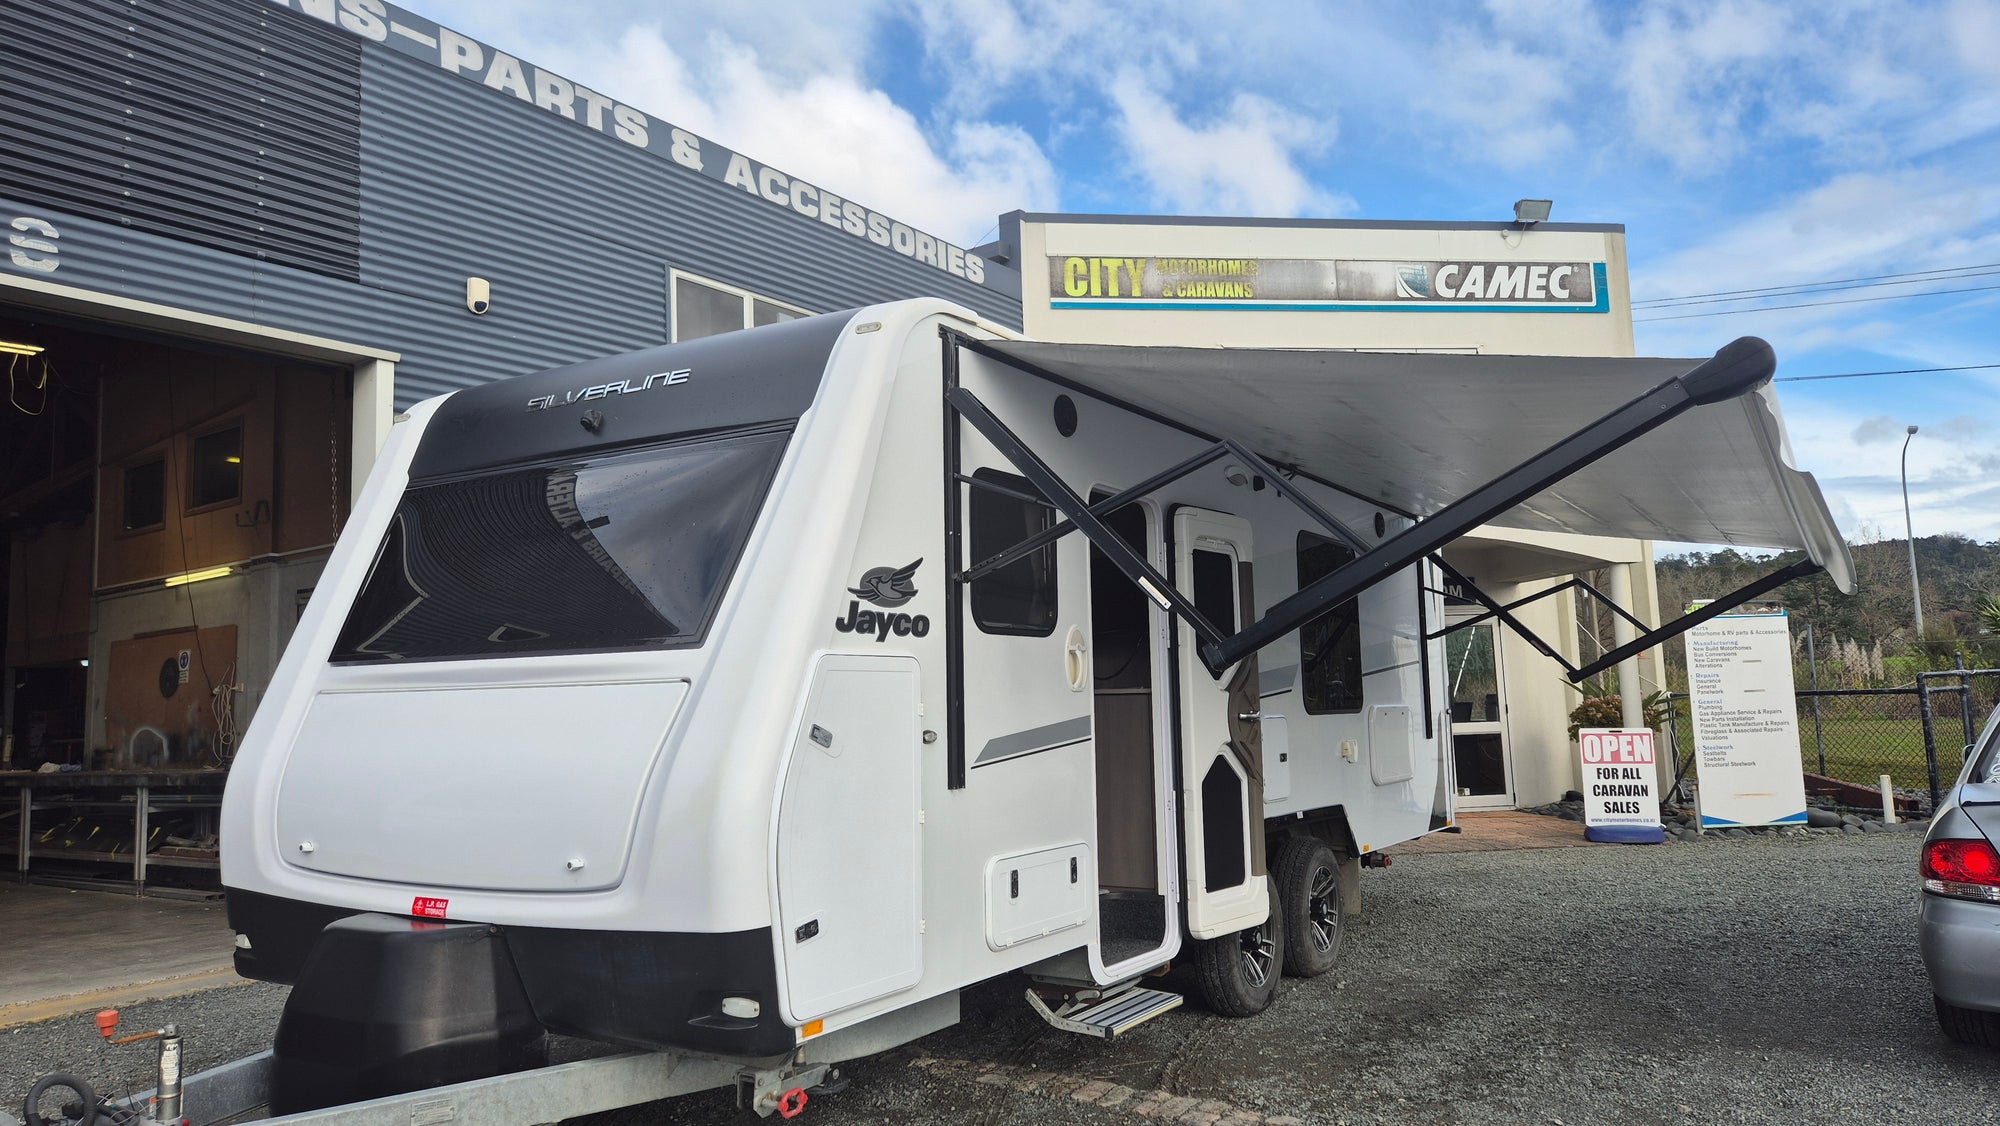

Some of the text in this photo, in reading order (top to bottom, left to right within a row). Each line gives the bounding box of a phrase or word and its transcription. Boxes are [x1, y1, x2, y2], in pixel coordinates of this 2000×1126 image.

[671, 133, 704, 173] &
[723, 153, 986, 285] ACCESSORIES
[1063, 257, 1147, 297] CITY
[1155, 259, 1259, 276] MOTORHOMES
[1435, 264, 1571, 299] CAMEC
[1161, 281, 1254, 298] & CARAVANS
[526, 368, 692, 412] SILVERLINE
[835, 600, 930, 643] Jayco
[1583, 735, 1652, 763] OPEN
[1596, 767, 1642, 780] FOR ALL
[1592, 784, 1649, 797] CARAVAN
[1604, 801, 1640, 814] SALES
